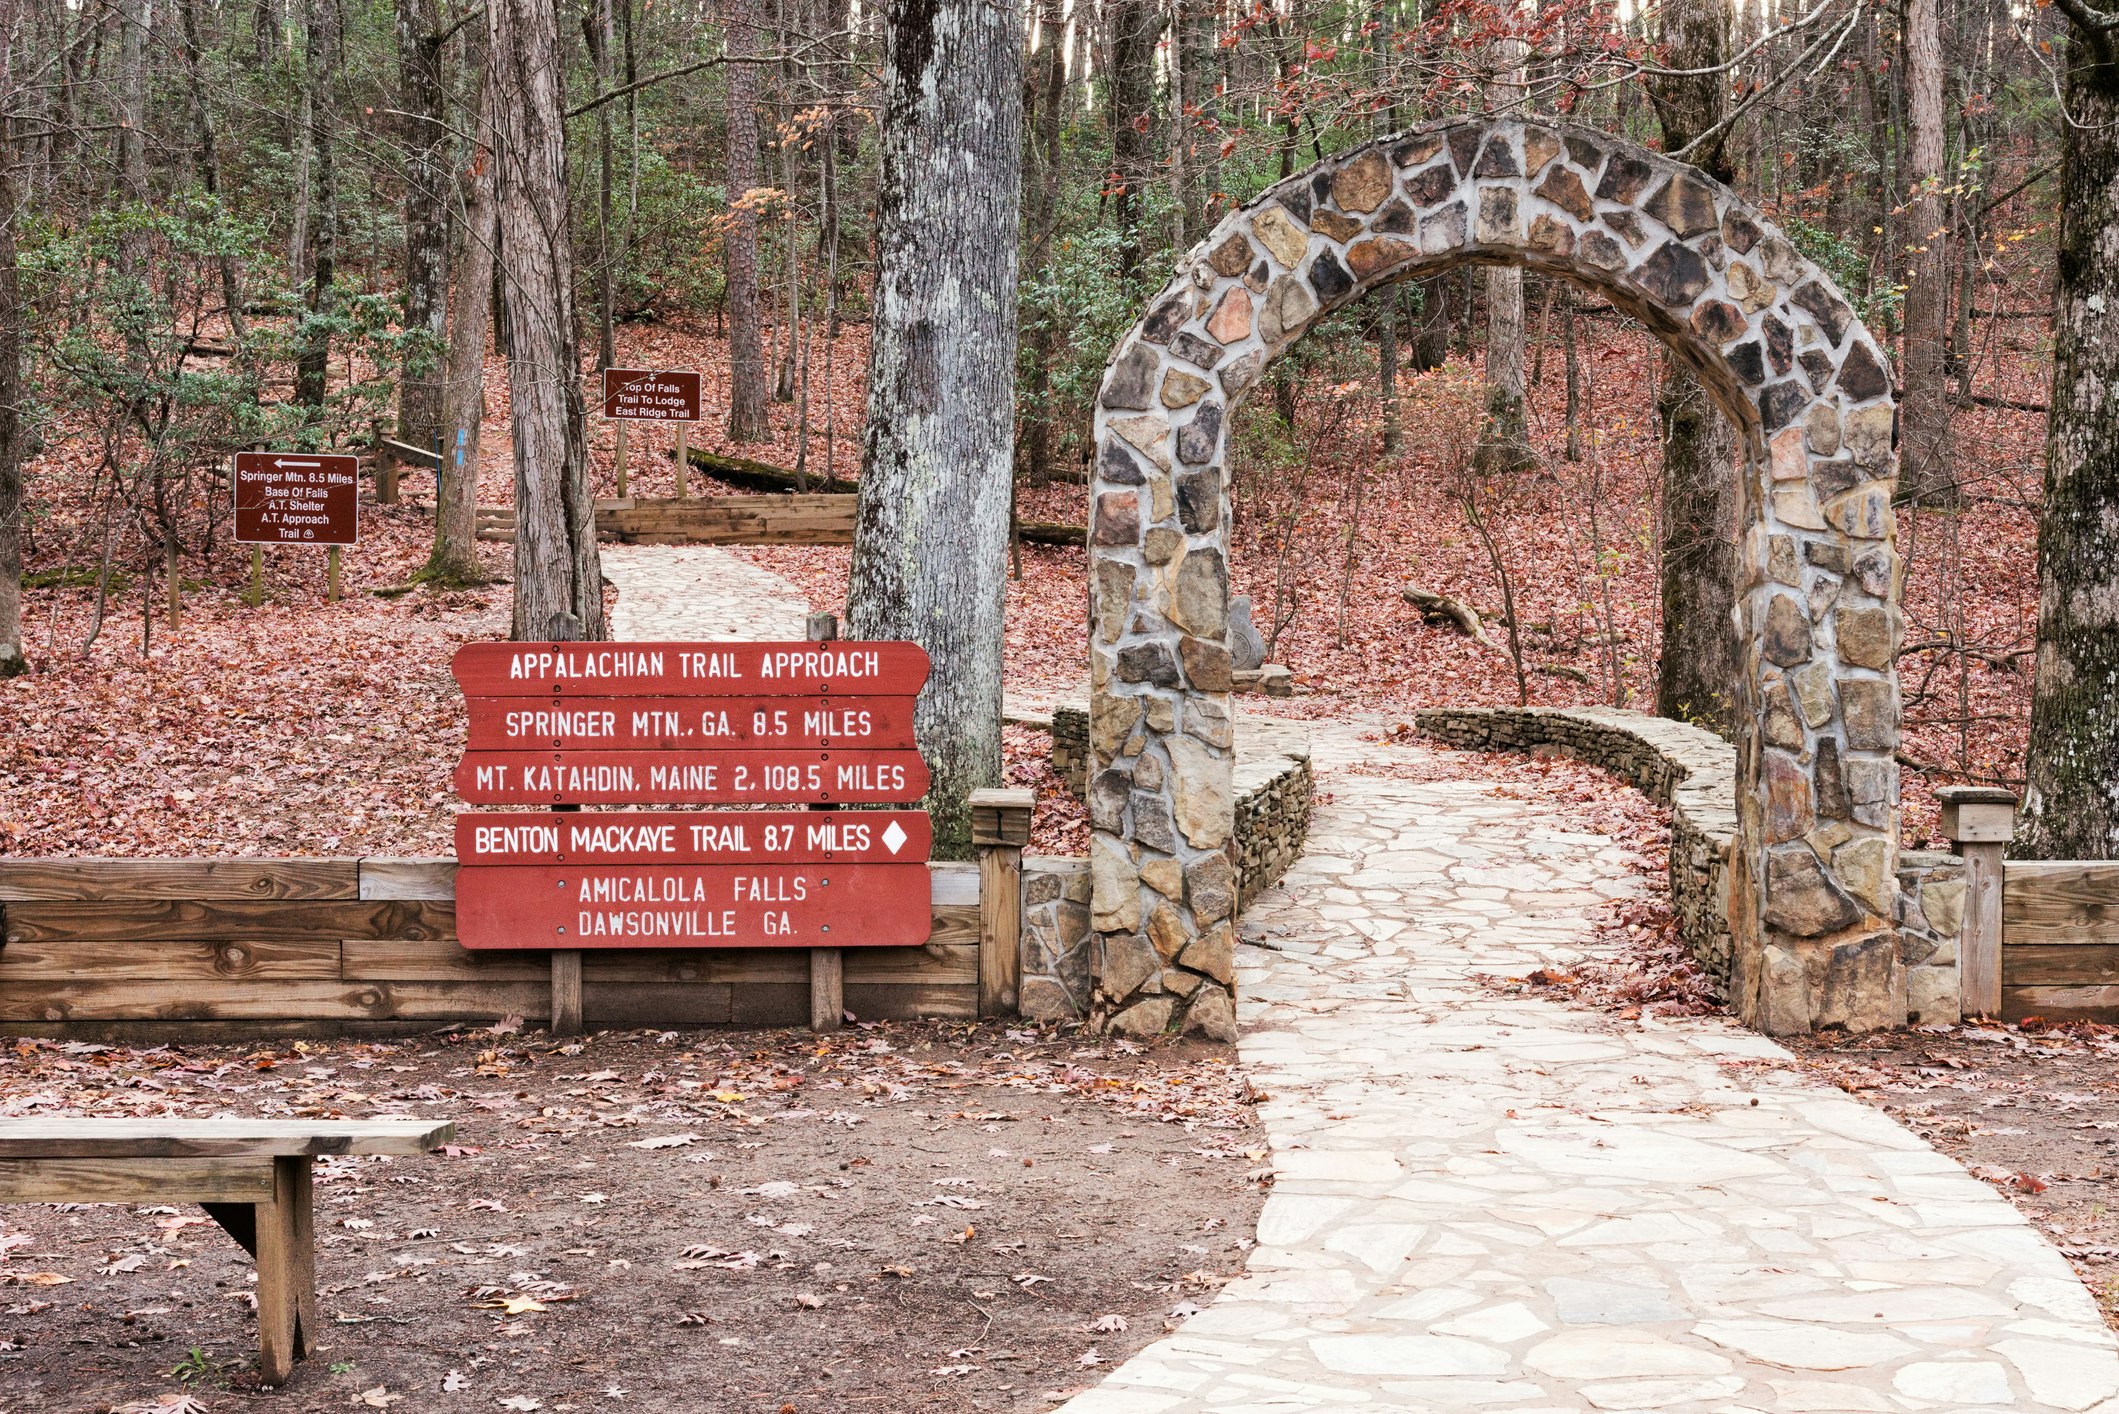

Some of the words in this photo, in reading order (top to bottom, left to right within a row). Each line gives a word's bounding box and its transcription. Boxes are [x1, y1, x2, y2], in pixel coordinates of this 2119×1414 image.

[624, 382, 642, 393] Top
[644, 383, 655, 392] Of
[658, 384, 680, 393] Falls
[618, 394, 638, 403] Trail
[641, 395, 653, 404] To
[656, 396, 685, 407] Lodge
[616, 407, 637, 416] East
[640, 408, 667, 418] Ridge
[669, 409, 689, 418] Trail
[241, 470, 283, 483] Springer
[285, 472, 306, 482] Mtn.
[309, 473, 325, 483] 8.5
[328, 473, 353, 484] Miles
[265, 486, 289, 497] Base
[292, 487, 303, 497] Of
[306, 488, 328, 498] Falls
[268, 500, 287, 510] A.T.
[290, 501, 324, 511] Shelter
[261, 513, 279, 523] A.T.
[282, 513, 329, 525] Approach
[279, 528, 299, 538] Trail
[511, 652, 663, 679] APPALACHIAN
[679, 653, 742, 678] TRAIL
[762, 652, 878, 678] APPROACH
[507, 711, 615, 736] SPRINGER
[702, 711, 735, 736] GA.
[754, 711, 787, 735] 8.5
[805, 711, 871, 736] MILES
[477, 766, 514, 790] MT.
[524, 766, 640, 791] KATAHDIN,
[651, 766, 717, 790] MAINE
[838, 765, 904, 790] MILES
[476, 826, 558, 853] BENTON
[571, 826, 675, 852] MACKAYE
[690, 825, 751, 851] TRAIL
[765, 825, 794, 851] 8.7
[808, 824, 870, 851] MILES
[579, 877, 705, 902] AMICALOLA
[734, 877, 806, 901] FALLS
[579, 911, 736, 935] DAWSONVILLE
[764, 911, 797, 935] GA.
